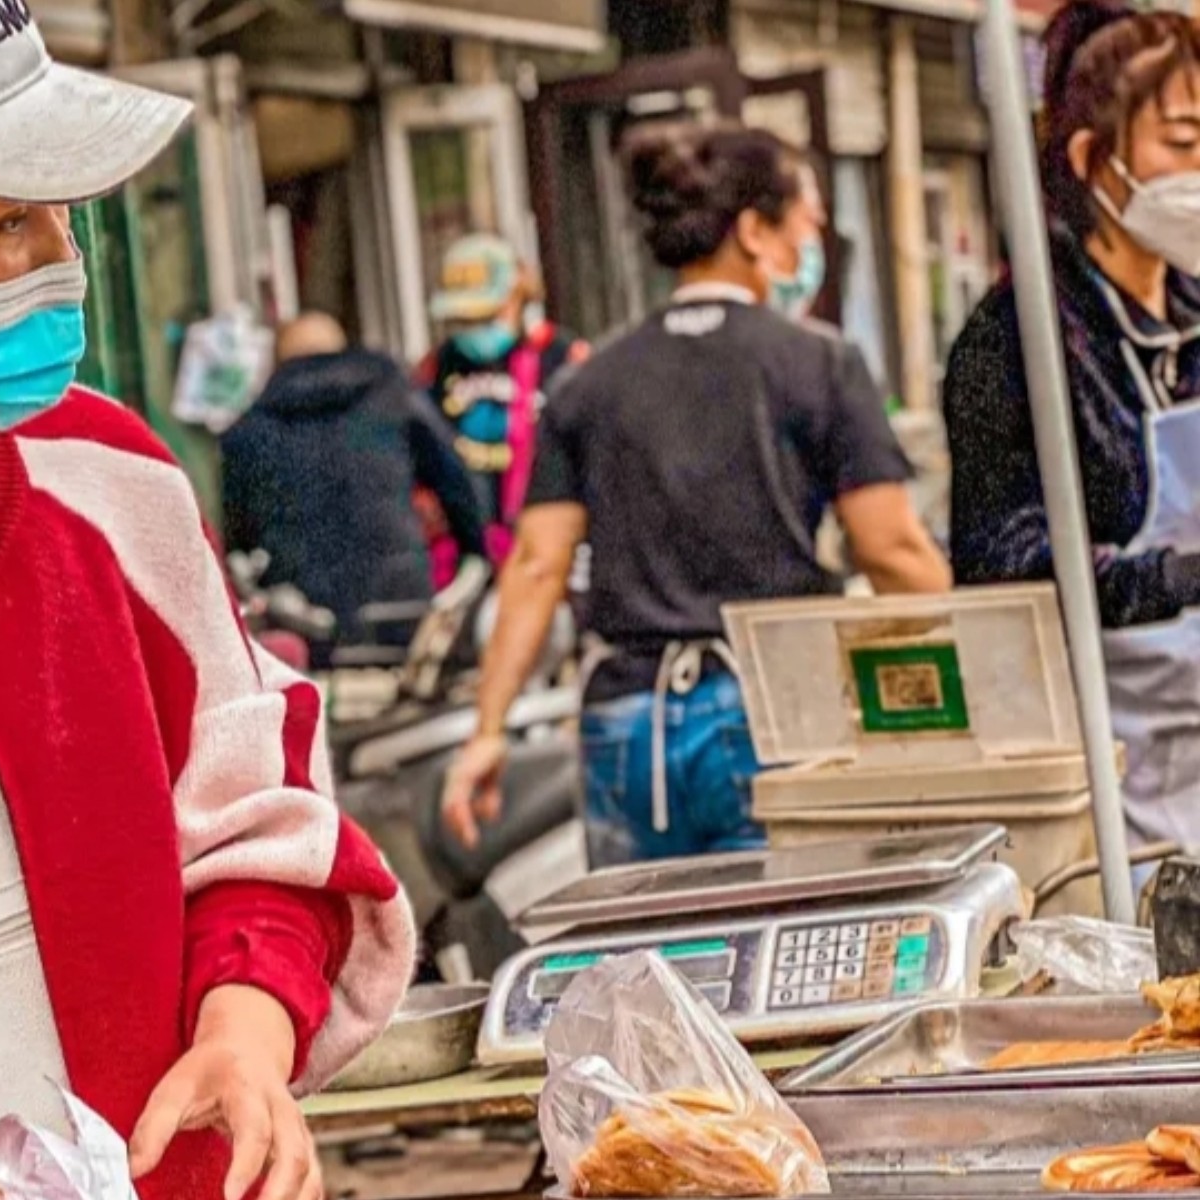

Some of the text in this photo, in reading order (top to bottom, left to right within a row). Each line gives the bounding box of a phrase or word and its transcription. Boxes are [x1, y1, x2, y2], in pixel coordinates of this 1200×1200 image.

[818, 928, 831, 943] 2
[849, 923, 861, 938] 3
[784, 944, 859, 963] 4 5 6
[813, 966, 826, 981] 8
